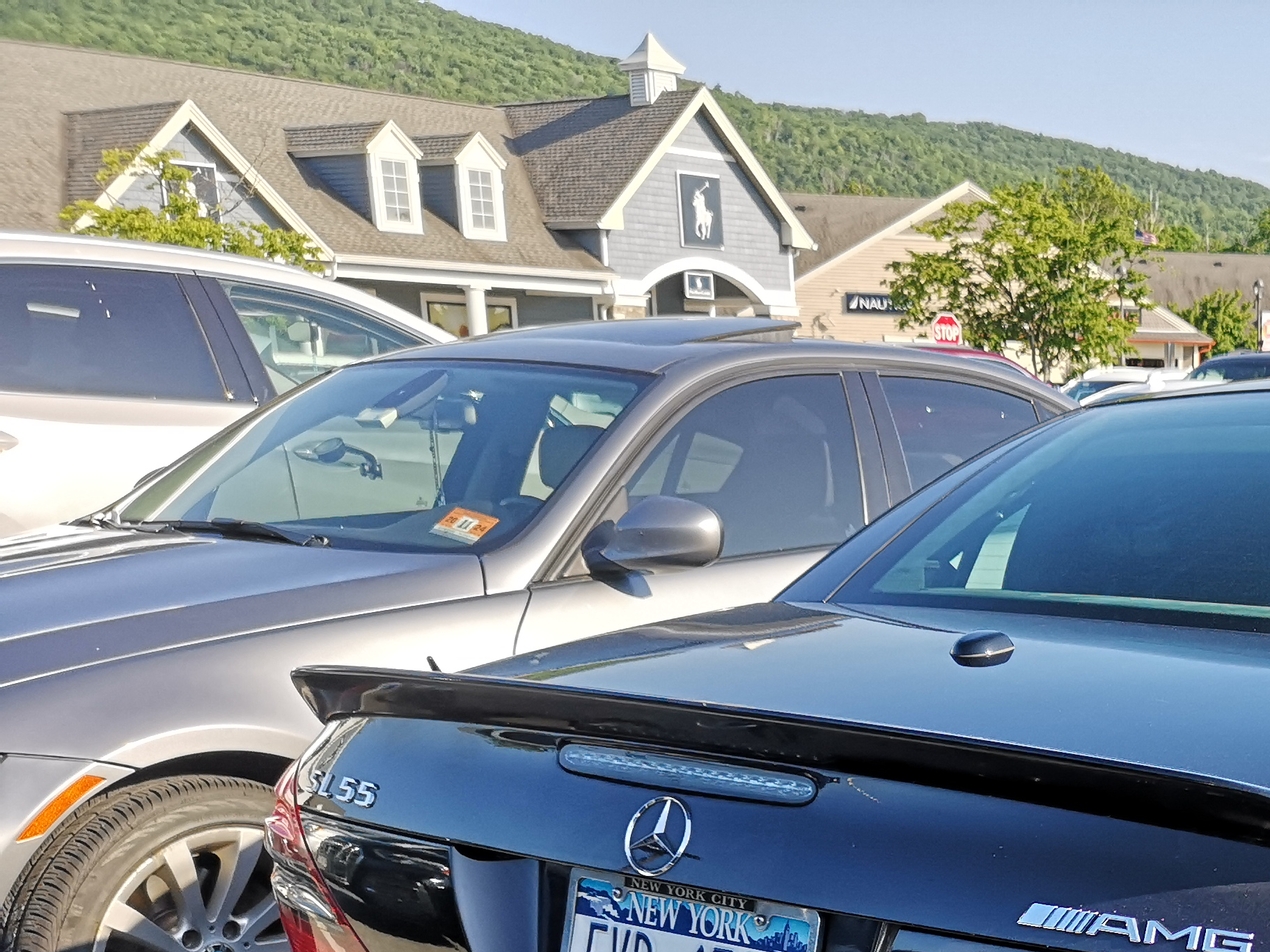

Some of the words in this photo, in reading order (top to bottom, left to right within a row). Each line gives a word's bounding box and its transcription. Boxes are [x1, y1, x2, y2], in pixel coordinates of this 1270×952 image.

[934, 323, 959, 341] STOP
[630, 878, 660, 893] NEW
[667, 884, 706, 902] YORK
[711, 893, 748, 910] CITY
[626, 891, 682, 930] NEW
[688, 902, 751, 945] YORK
